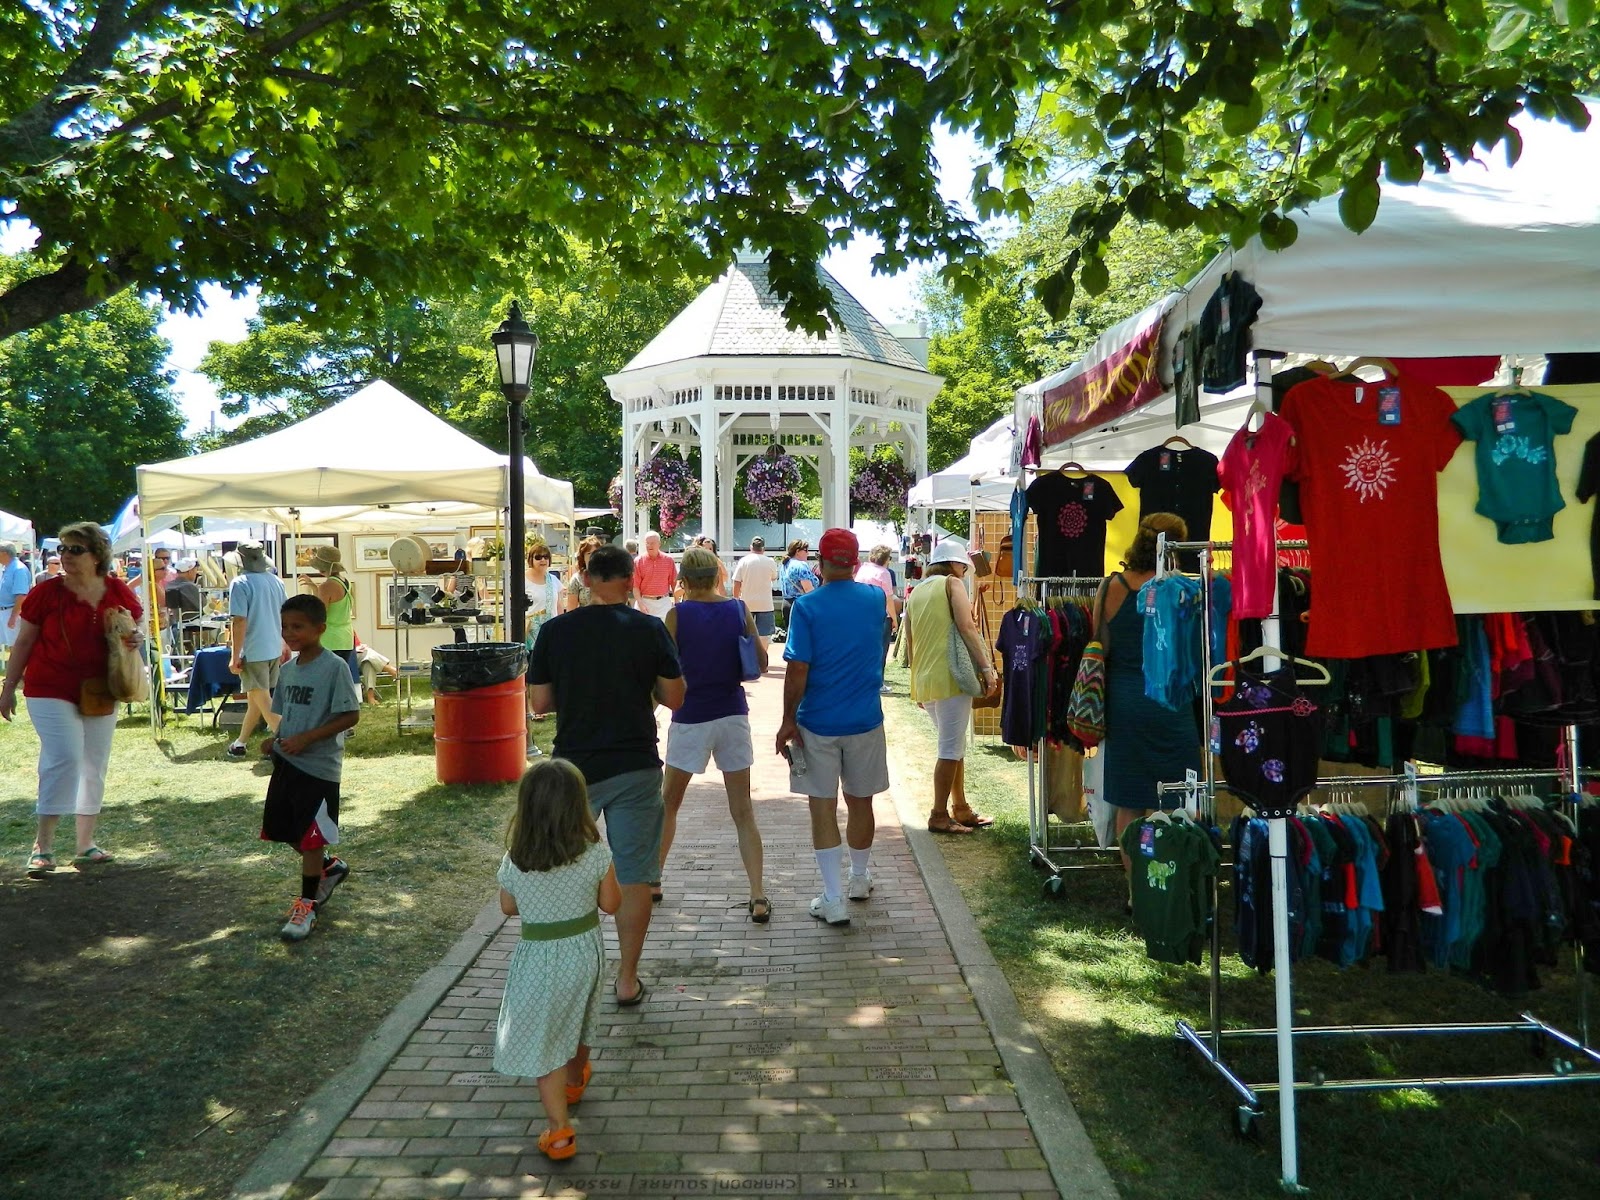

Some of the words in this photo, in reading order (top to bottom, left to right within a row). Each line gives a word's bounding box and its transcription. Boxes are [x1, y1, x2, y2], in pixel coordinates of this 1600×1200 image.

[641, 1178, 708, 1189] SQUARE
[719, 1179, 795, 1190] CHARDON
[827, 1178, 858, 1189] THE
